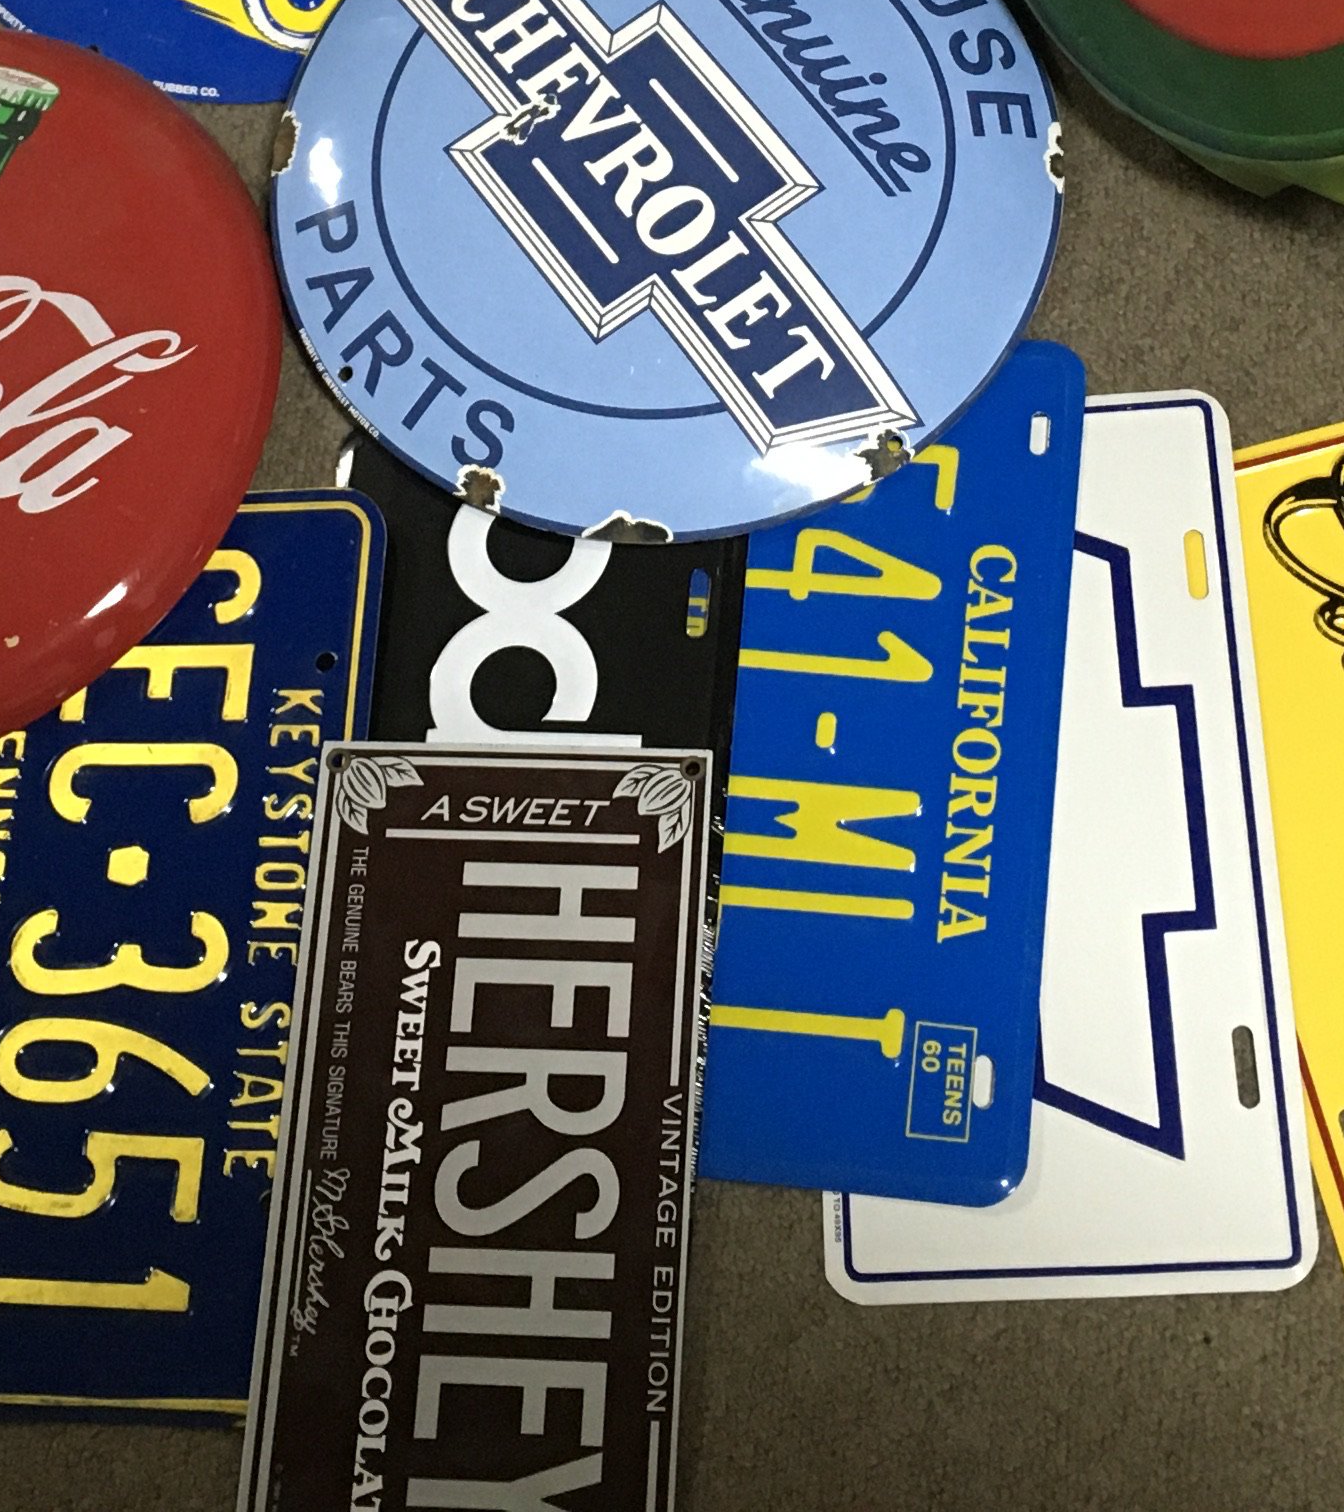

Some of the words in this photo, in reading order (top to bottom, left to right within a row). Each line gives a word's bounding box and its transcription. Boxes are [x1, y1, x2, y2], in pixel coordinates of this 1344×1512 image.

[295, 199, 516, 470] PARTS
[937, 543, 1018, 945] CALIFORNIA
[245, 687, 323, 967] KEYSTONE
[350, 846, 370, 878] THE
[421, 796, 455, 823] A
[459, 796, 613, 829] SWEET
[342, 883, 366, 952] GENUINE
[330, 1019, 352, 1059] THIS
[335, 959, 357, 1015] BEARS
[390, 939, 442, 1091] SWEET
[222, 1001, 292, 1180] STATE
[319, 1064, 346, 1162] SIGNATURE
[921, 1039, 942, 1073] 60
[942, 1042, 967, 1126] TEENS
[374, 1097, 425, 1262] MILK
[656, 1093, 684, 1248] VINTAGE
[645, 1266, 676, 1413] EDITION
